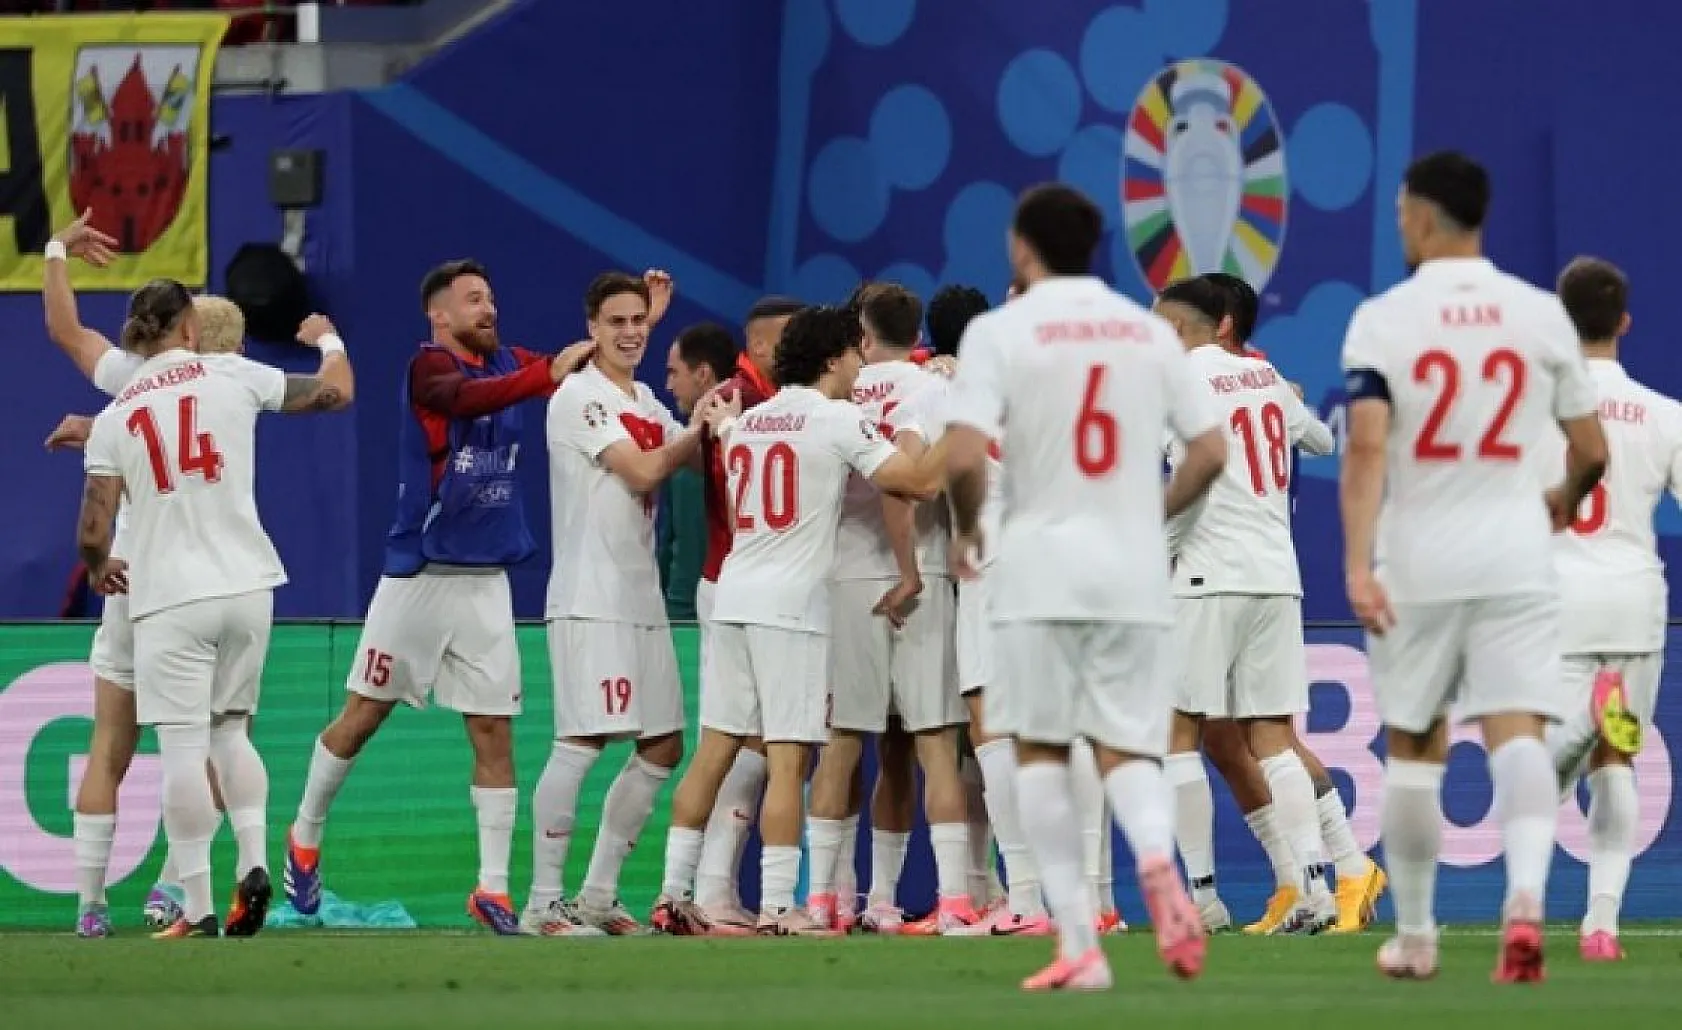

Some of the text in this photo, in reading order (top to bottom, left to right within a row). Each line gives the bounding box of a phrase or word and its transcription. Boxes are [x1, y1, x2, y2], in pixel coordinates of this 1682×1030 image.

[126, 395, 224, 494] 14
[1073, 361, 1119, 478] 6
[1230, 402, 1289, 497] 18
[1411, 347, 1528, 461] 22
[729, 440, 800, 534] 20
[364, 648, 393, 687] 15
[600, 676, 632, 716] 19
